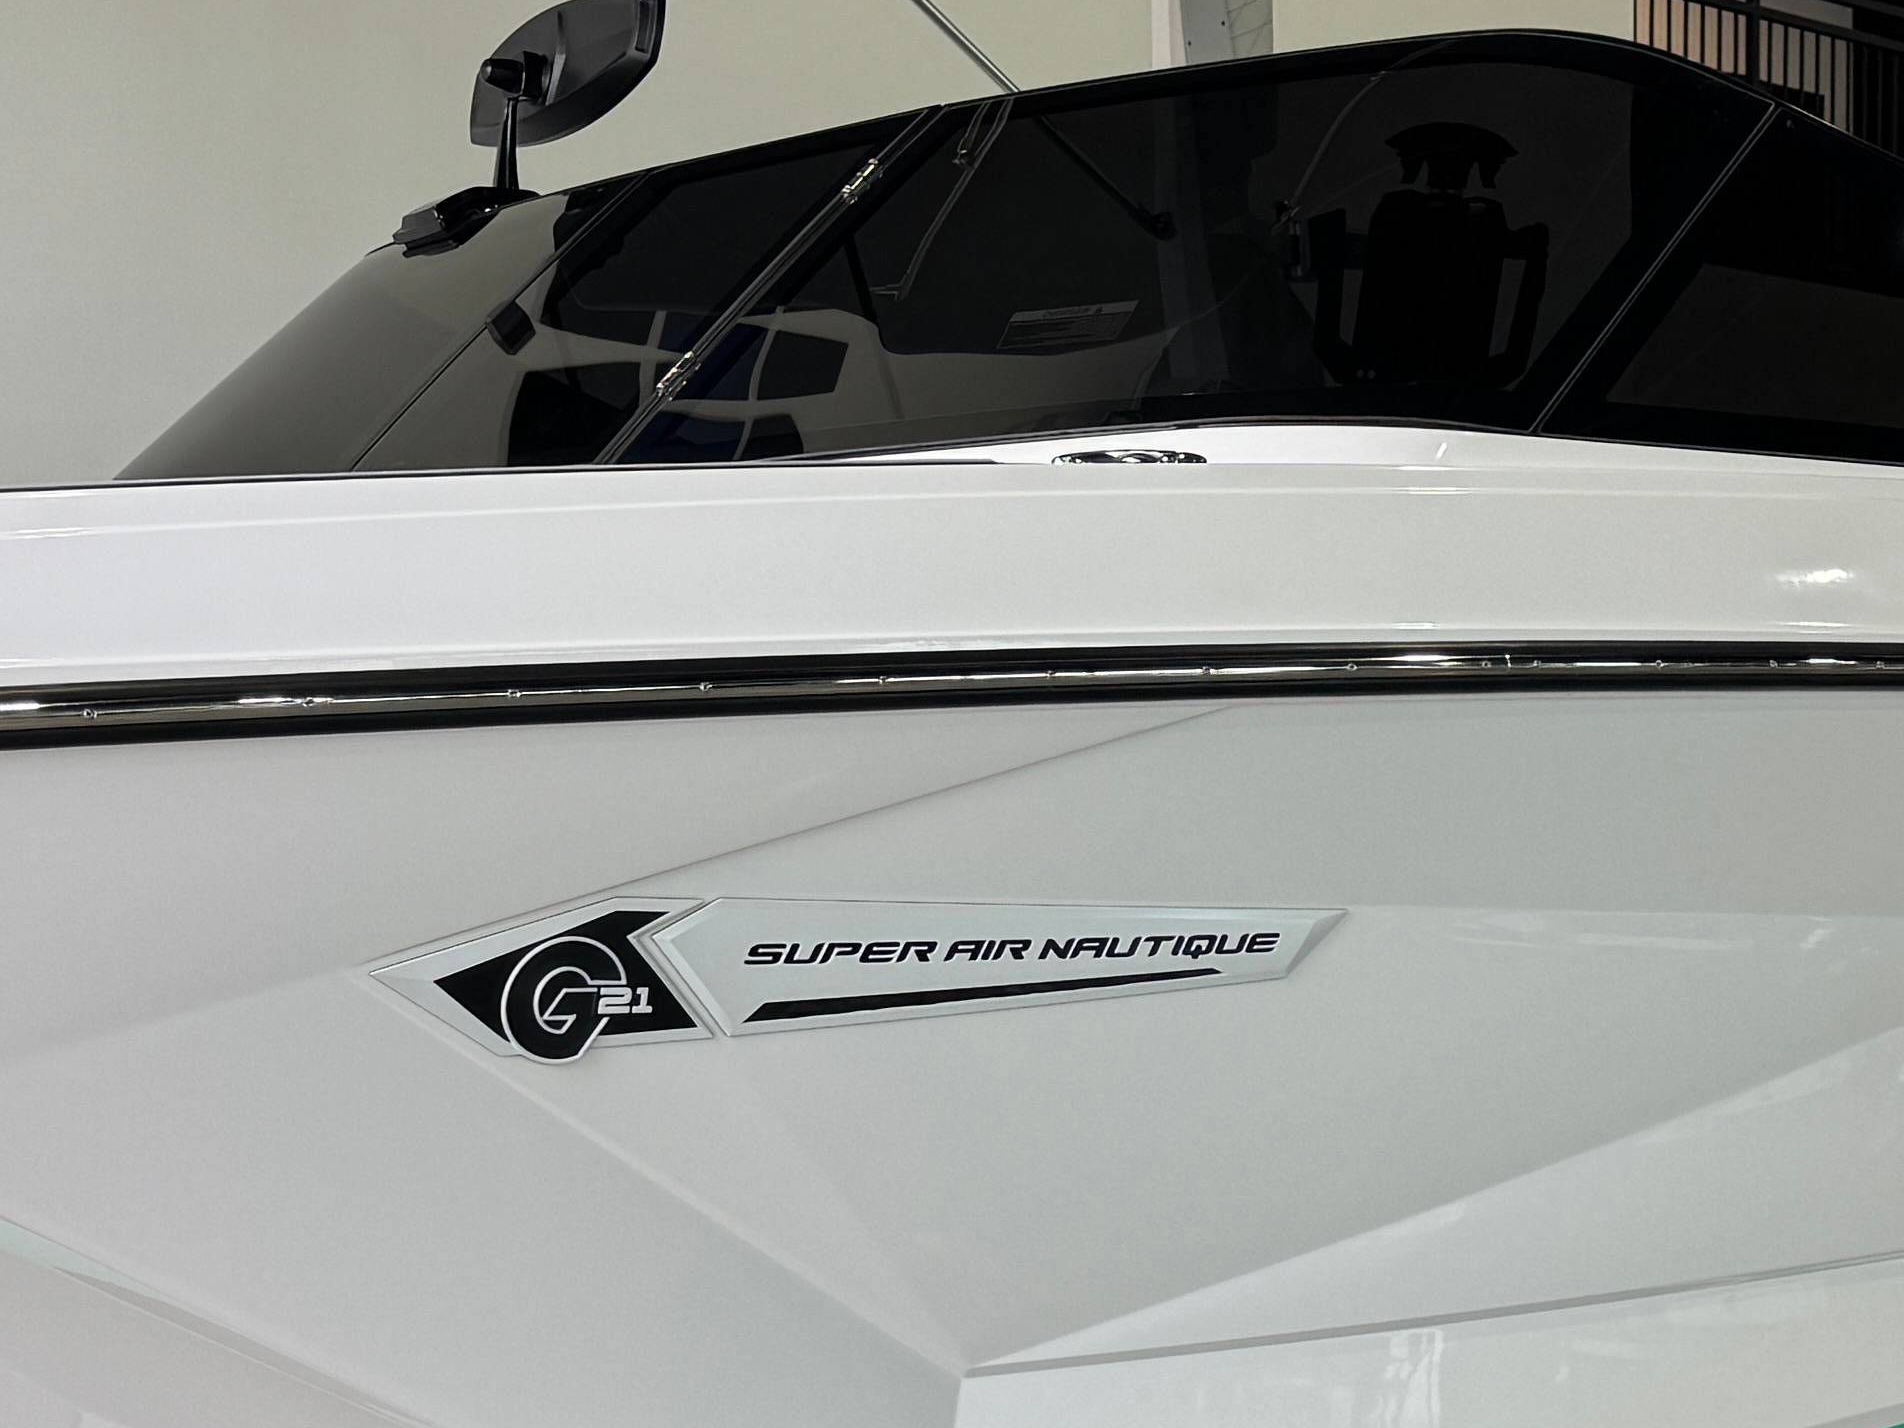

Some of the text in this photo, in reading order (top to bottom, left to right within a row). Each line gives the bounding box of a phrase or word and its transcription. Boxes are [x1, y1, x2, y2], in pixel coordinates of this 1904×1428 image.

[743, 932, 1281, 965] SUPER AIR NAUTIQUE
